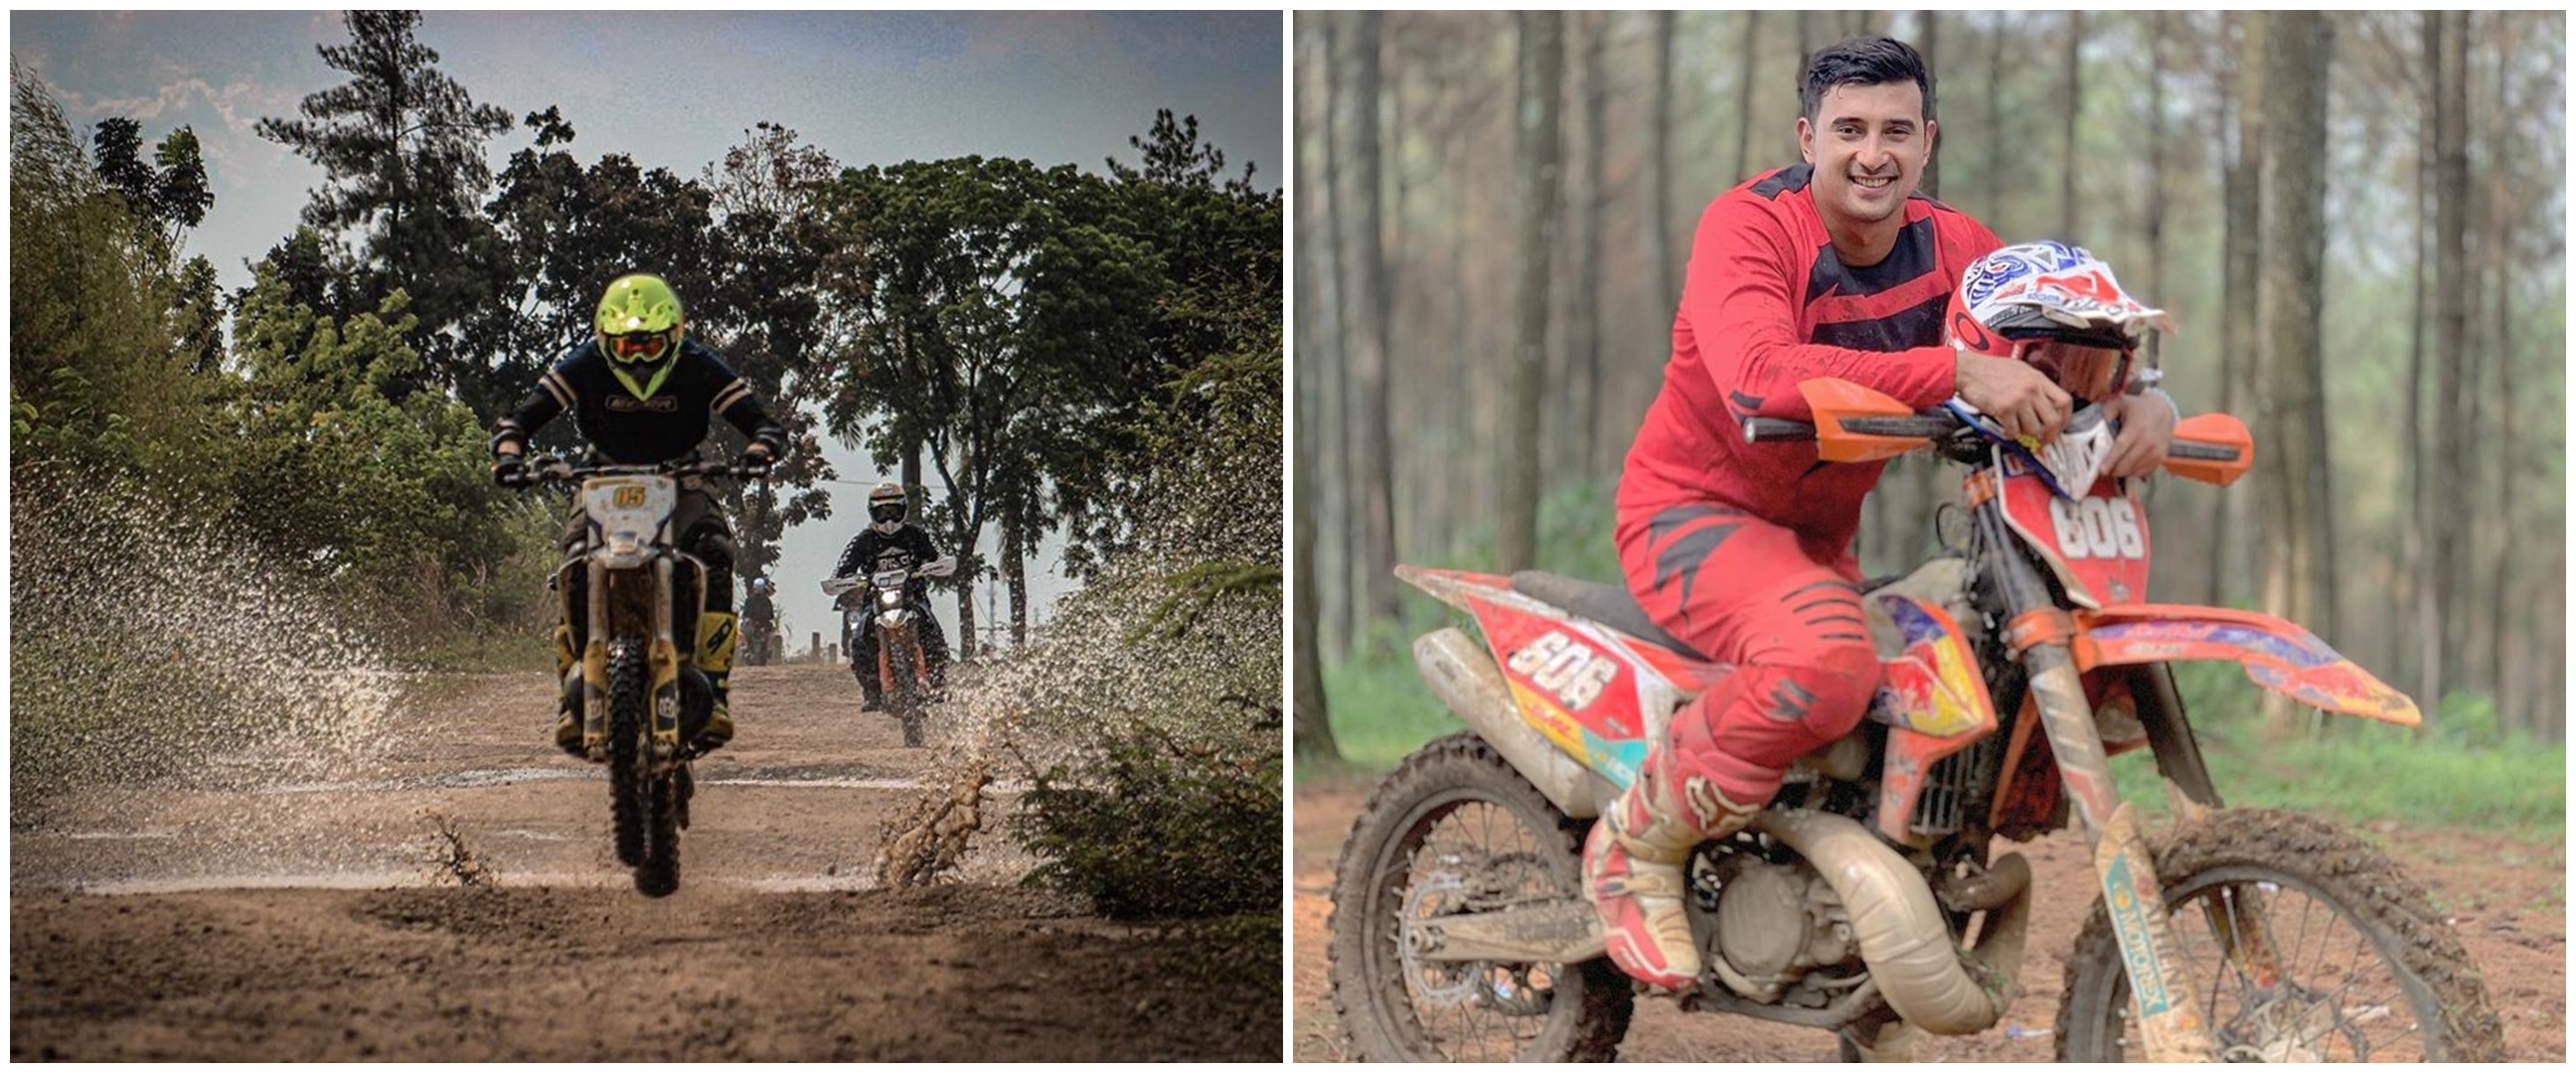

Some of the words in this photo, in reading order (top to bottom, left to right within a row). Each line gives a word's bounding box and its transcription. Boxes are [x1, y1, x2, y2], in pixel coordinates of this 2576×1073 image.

[2049, 496, 2145, 559] 606
[1508, 630, 1619, 711] 606
[2118, 908, 2163, 1009] MOTOREX
